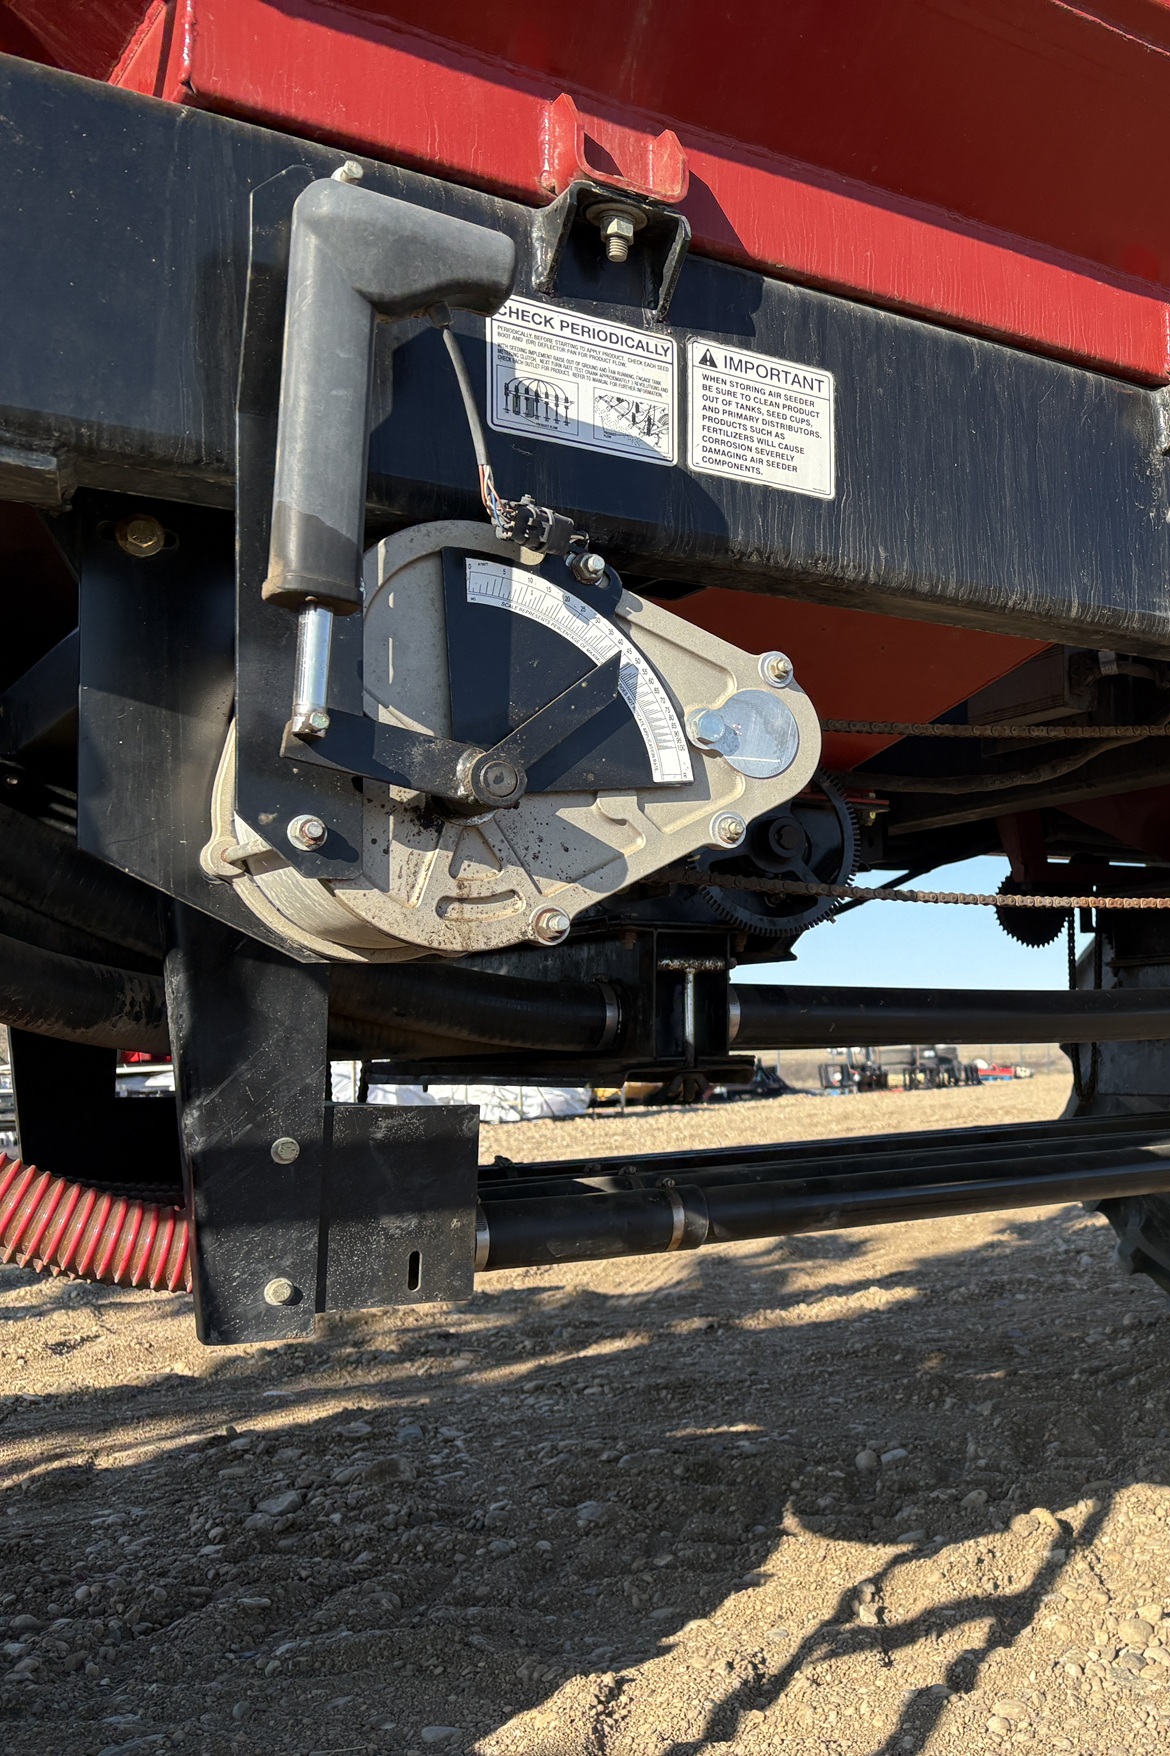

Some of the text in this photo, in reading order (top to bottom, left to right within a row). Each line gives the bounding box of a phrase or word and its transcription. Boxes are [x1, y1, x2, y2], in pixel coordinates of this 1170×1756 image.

[497, 304, 670, 359] CHECK PERIODICALLY
[497, 332, 510, 340] BOOT
[537, 341, 566, 353] DEFLECTOR
[589, 354, 611, 364] PRODUCT
[534, 334, 553, 345] BEFORE
[555, 340, 578, 350] STARTING
[586, 348, 601, 356] APPLY
[628, 358, 642, 366] CHECK
[644, 360, 656, 369] EACH
[657, 364, 669, 372] SEED
[702, 373, 815, 408] WHEN STORING AIR SEEDER
[724, 355, 824, 393] IMPORTANT
[702, 384, 820, 418] BE SURE TO CLEAN PRODUCT
[702, 394, 813, 428] OUT OF TANKS, SEED CUPS,
[702, 404, 822, 440] AND PRIMARY DISTRIBUTORS.
[702, 414, 786, 440] PRODUCTS SUCH AS
[702, 424, 805, 455] FERTILIZERS WILL CAUSE
[702, 435, 795, 462] CORROSION SEVERELY
[702, 445, 798, 473] DAMAGING AIR SEEDER
[702, 456, 764, 476] COMPONENTS.
[501, 601, 518, 611] SCALE
[518, 606, 550, 625] REPRESENTS
[551, 621, 580, 646] PERCENTAGE
[586, 648, 604, 665] MAXIMU
[608, 628, 614, 636] 35
